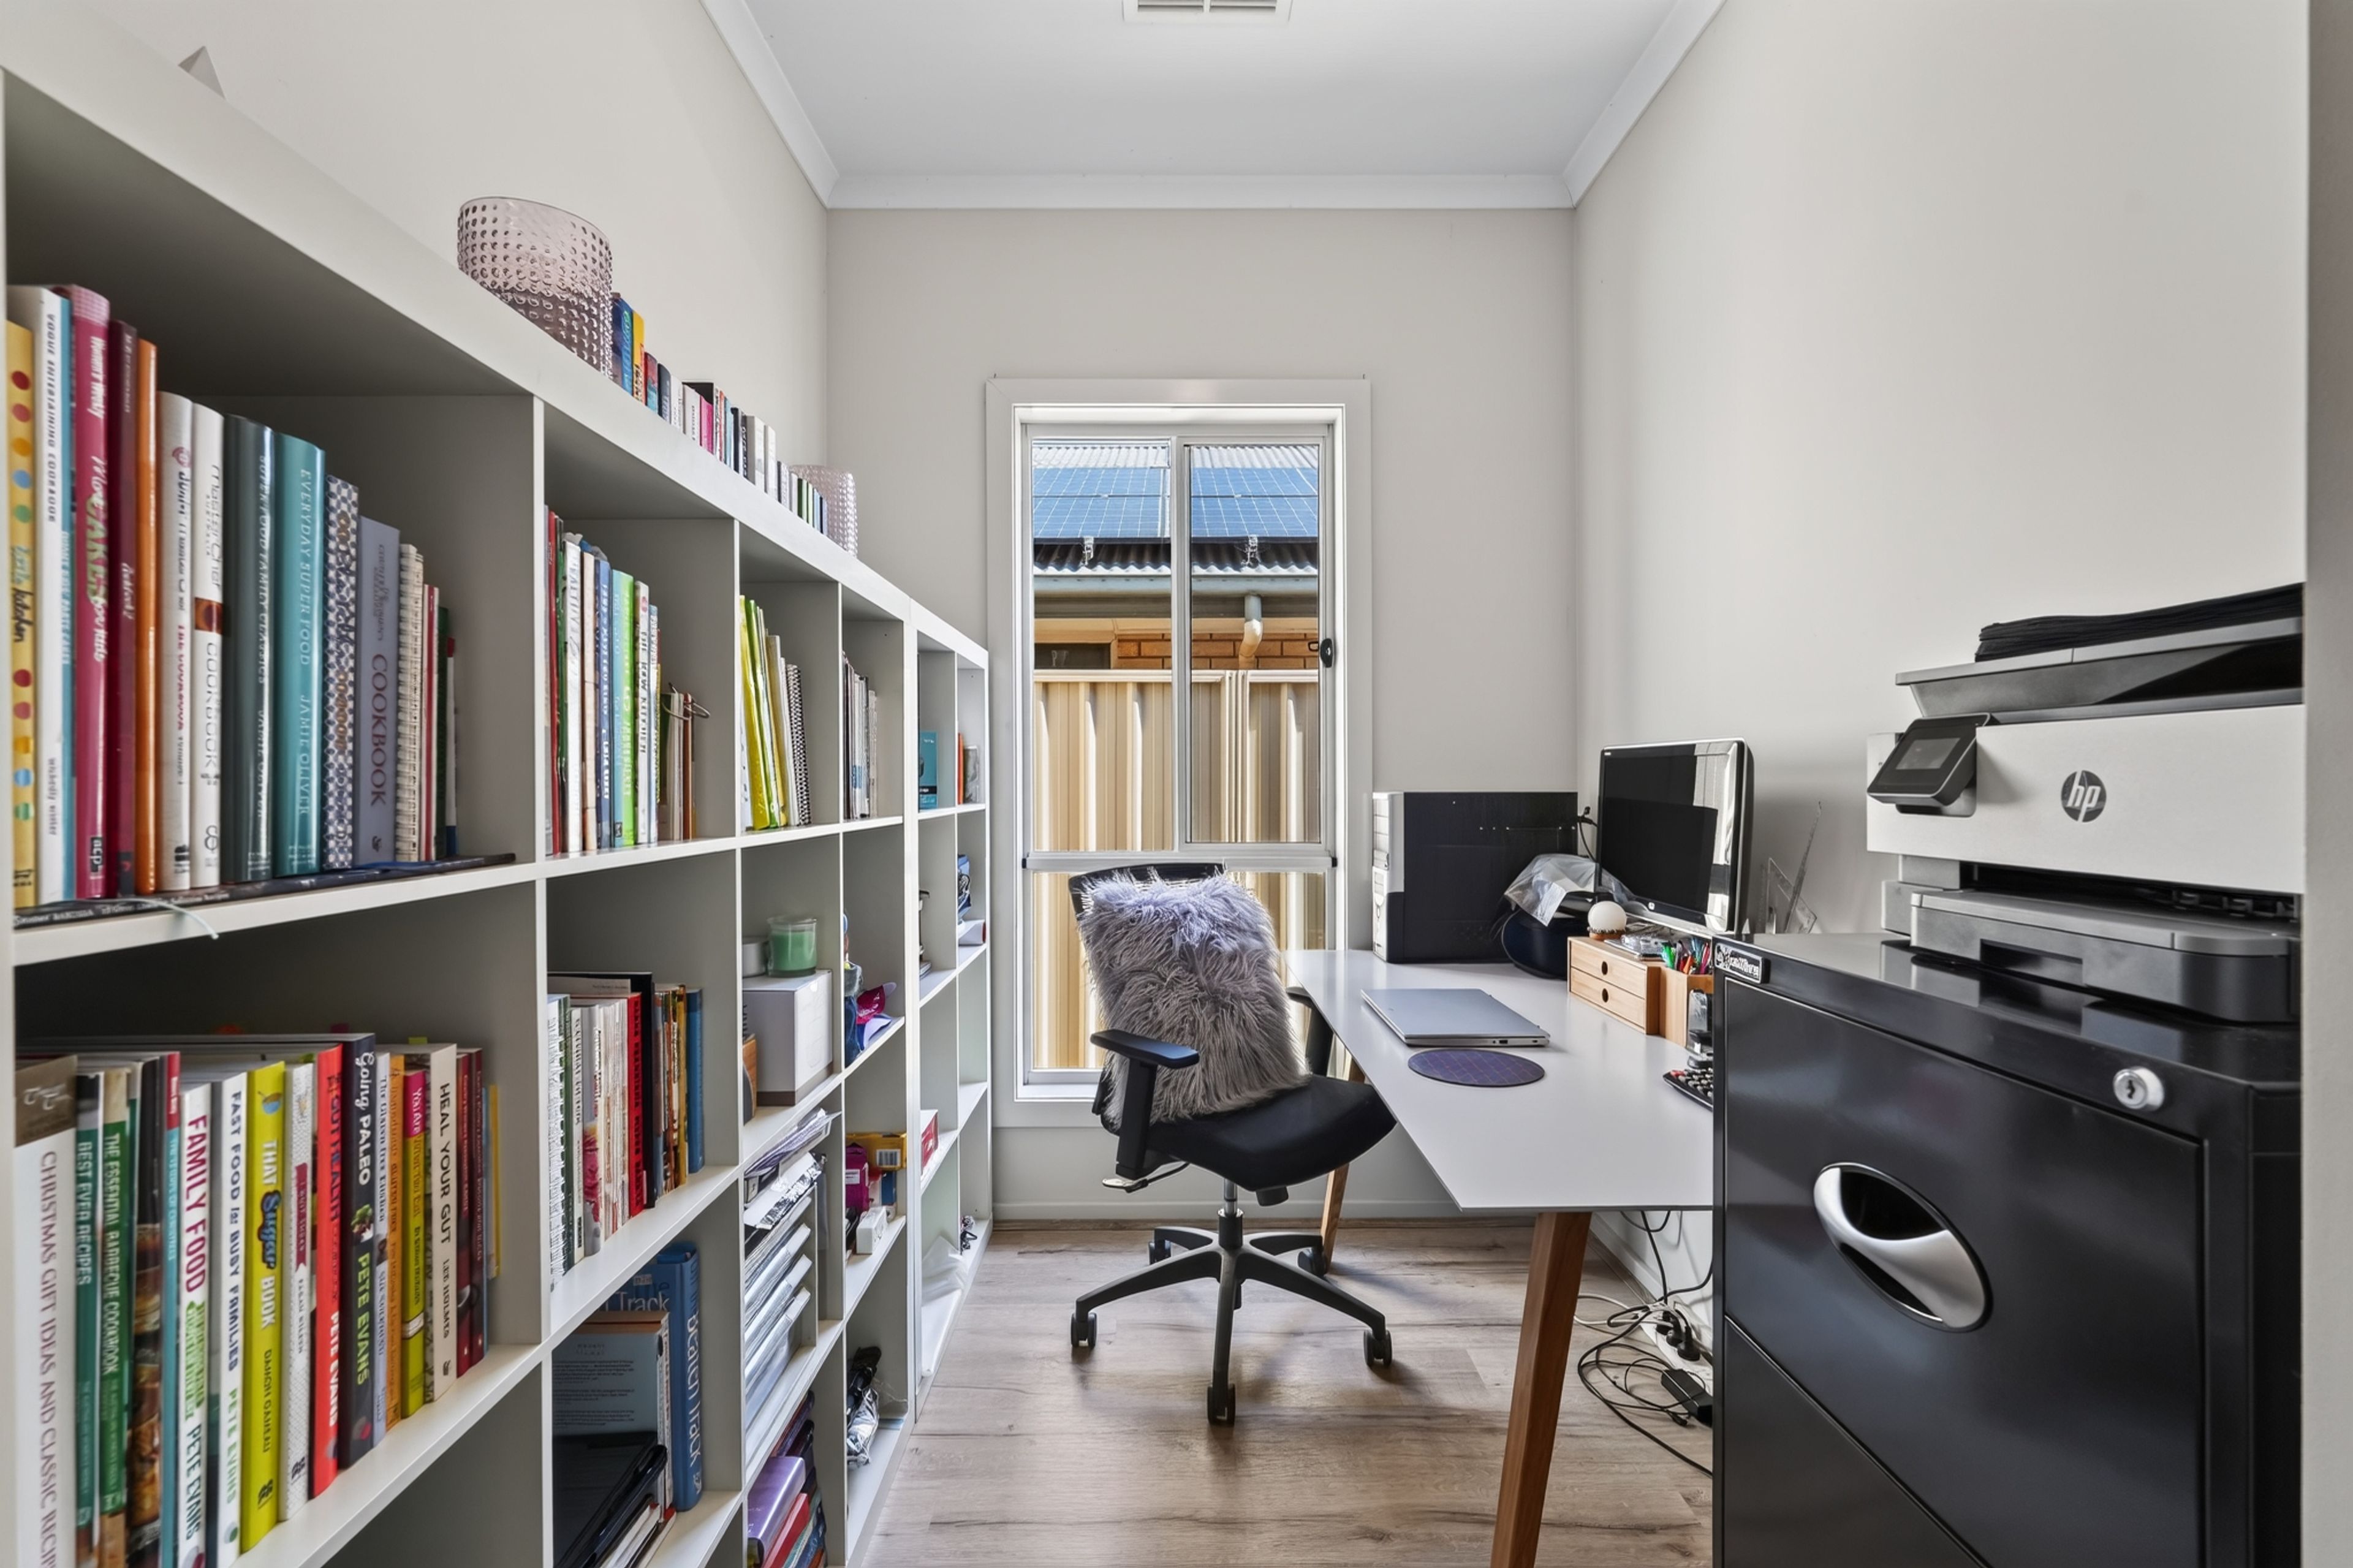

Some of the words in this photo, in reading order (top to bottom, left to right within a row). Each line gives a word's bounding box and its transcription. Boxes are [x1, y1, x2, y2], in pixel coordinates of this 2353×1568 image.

[47, 314, 56, 355] VOGUE
[47, 360, 57, 448] ENTERTAINING
[47, 453, 56, 523] COOKBOOK
[300, 469, 311, 557] EVERYDAY
[86, 496, 108, 604] CAKES
[300, 561, 311, 614] SUPER
[300, 619, 311, 665] FOOD
[206, 643, 220, 770] COOKBOOK
[300, 695, 311, 746] JAMIE
[370, 653, 388, 807] COOKBOOK
[299, 753, 310, 815] OLIVER
[2067, 770, 2101, 822] hp
[354, 1051, 375, 1112] Going
[412, 1087, 422, 1112] You
[439, 1083, 451, 1137] HEAL
[230, 1091, 241, 1136] FAST
[412, 1112, 423, 1134] Are
[77, 1142, 93, 1178] BEST
[104, 1133, 120, 1159] THE
[186, 1115, 207, 1213] FAMILY
[230, 1143, 241, 1200] FOOD
[262, 1140, 278, 1187] THAT
[358, 1113, 372, 1187] PALEO
[440, 1140, 451, 1199] YOUR
[39, 1151, 58, 1265] CHRISTMAS
[77, 1182, 93, 1222] EVER
[104, 1161, 120, 1225] ESSENTIAL
[441, 1203, 451, 1244] GUT
[76, 1225, 92, 1286] RECIPES
[103, 1230, 119, 1299] BARBECUE
[185, 1218, 207, 1293] FOOD
[229, 1230, 240, 1277] BUSY
[357, 1252, 371, 1309] PETE
[39, 1268, 58, 1313] GIFT
[260, 1274, 276, 1330] BOOK
[615, 1291, 670, 1312] Track
[39, 1317, 57, 1376] IDEAS
[102, 1301, 120, 1376] COOKBOOK
[228, 1284, 240, 1372] FAMILIES
[330, 1309, 340, 1358] PETE
[357, 1311, 370, 1386] EVANS
[39, 1381, 56, 1425] AND
[227, 1386, 238, 1439] PETE
[329, 1358, 339, 1428] EVANS
[40, 1428, 57, 1510] CLASSIC
[185, 1423, 203, 1478] PETE
[227, 1441, 238, 1504] EVANS
[186, 1475, 202, 1541] EVANS
